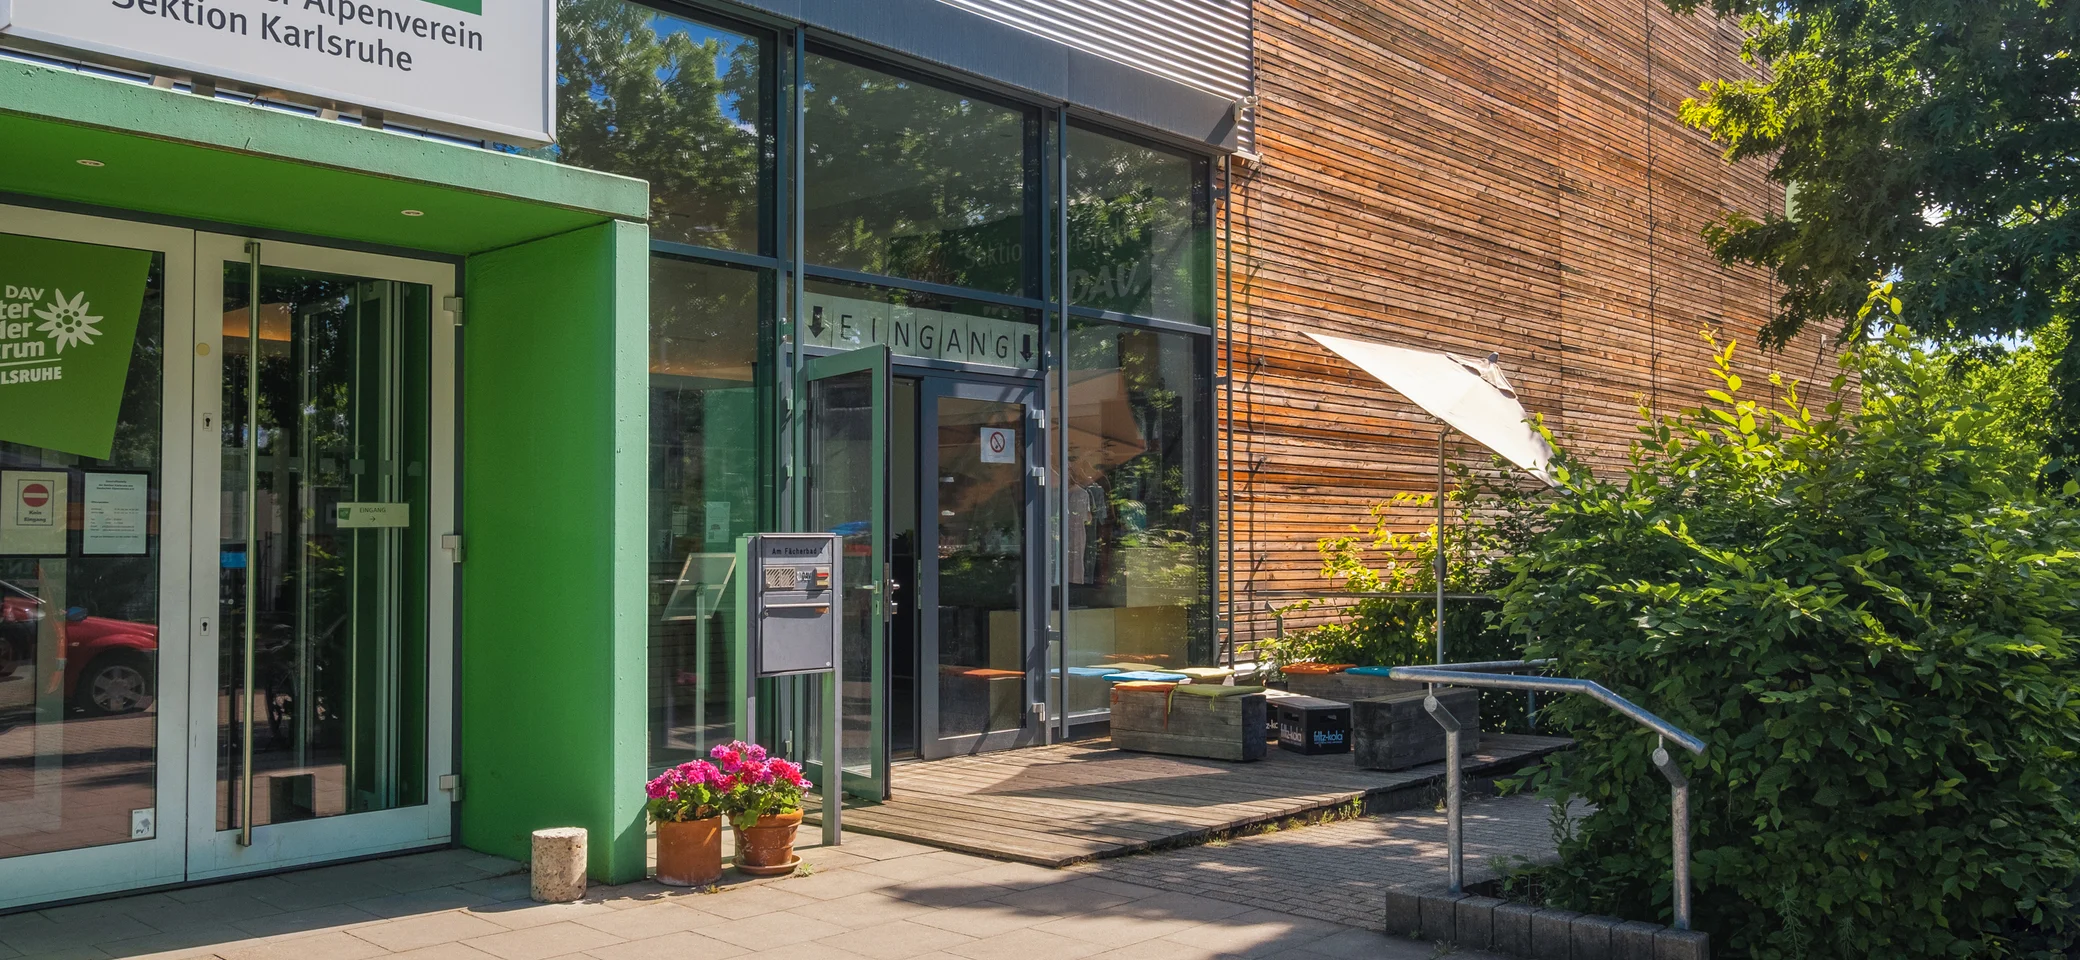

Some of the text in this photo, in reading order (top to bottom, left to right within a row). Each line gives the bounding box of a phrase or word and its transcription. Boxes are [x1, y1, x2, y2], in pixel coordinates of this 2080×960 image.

[261, 12, 413, 71] Karlsruhe
[5, 285, 45, 301] DAV
[840, 314, 1010, 359] EINGANG
[0, 340, 45, 360] rum
[359, 506, 387, 514] EINGANG
[771, 547, 782, 555] Am
[784, 547, 817, 555] Fächerbad
